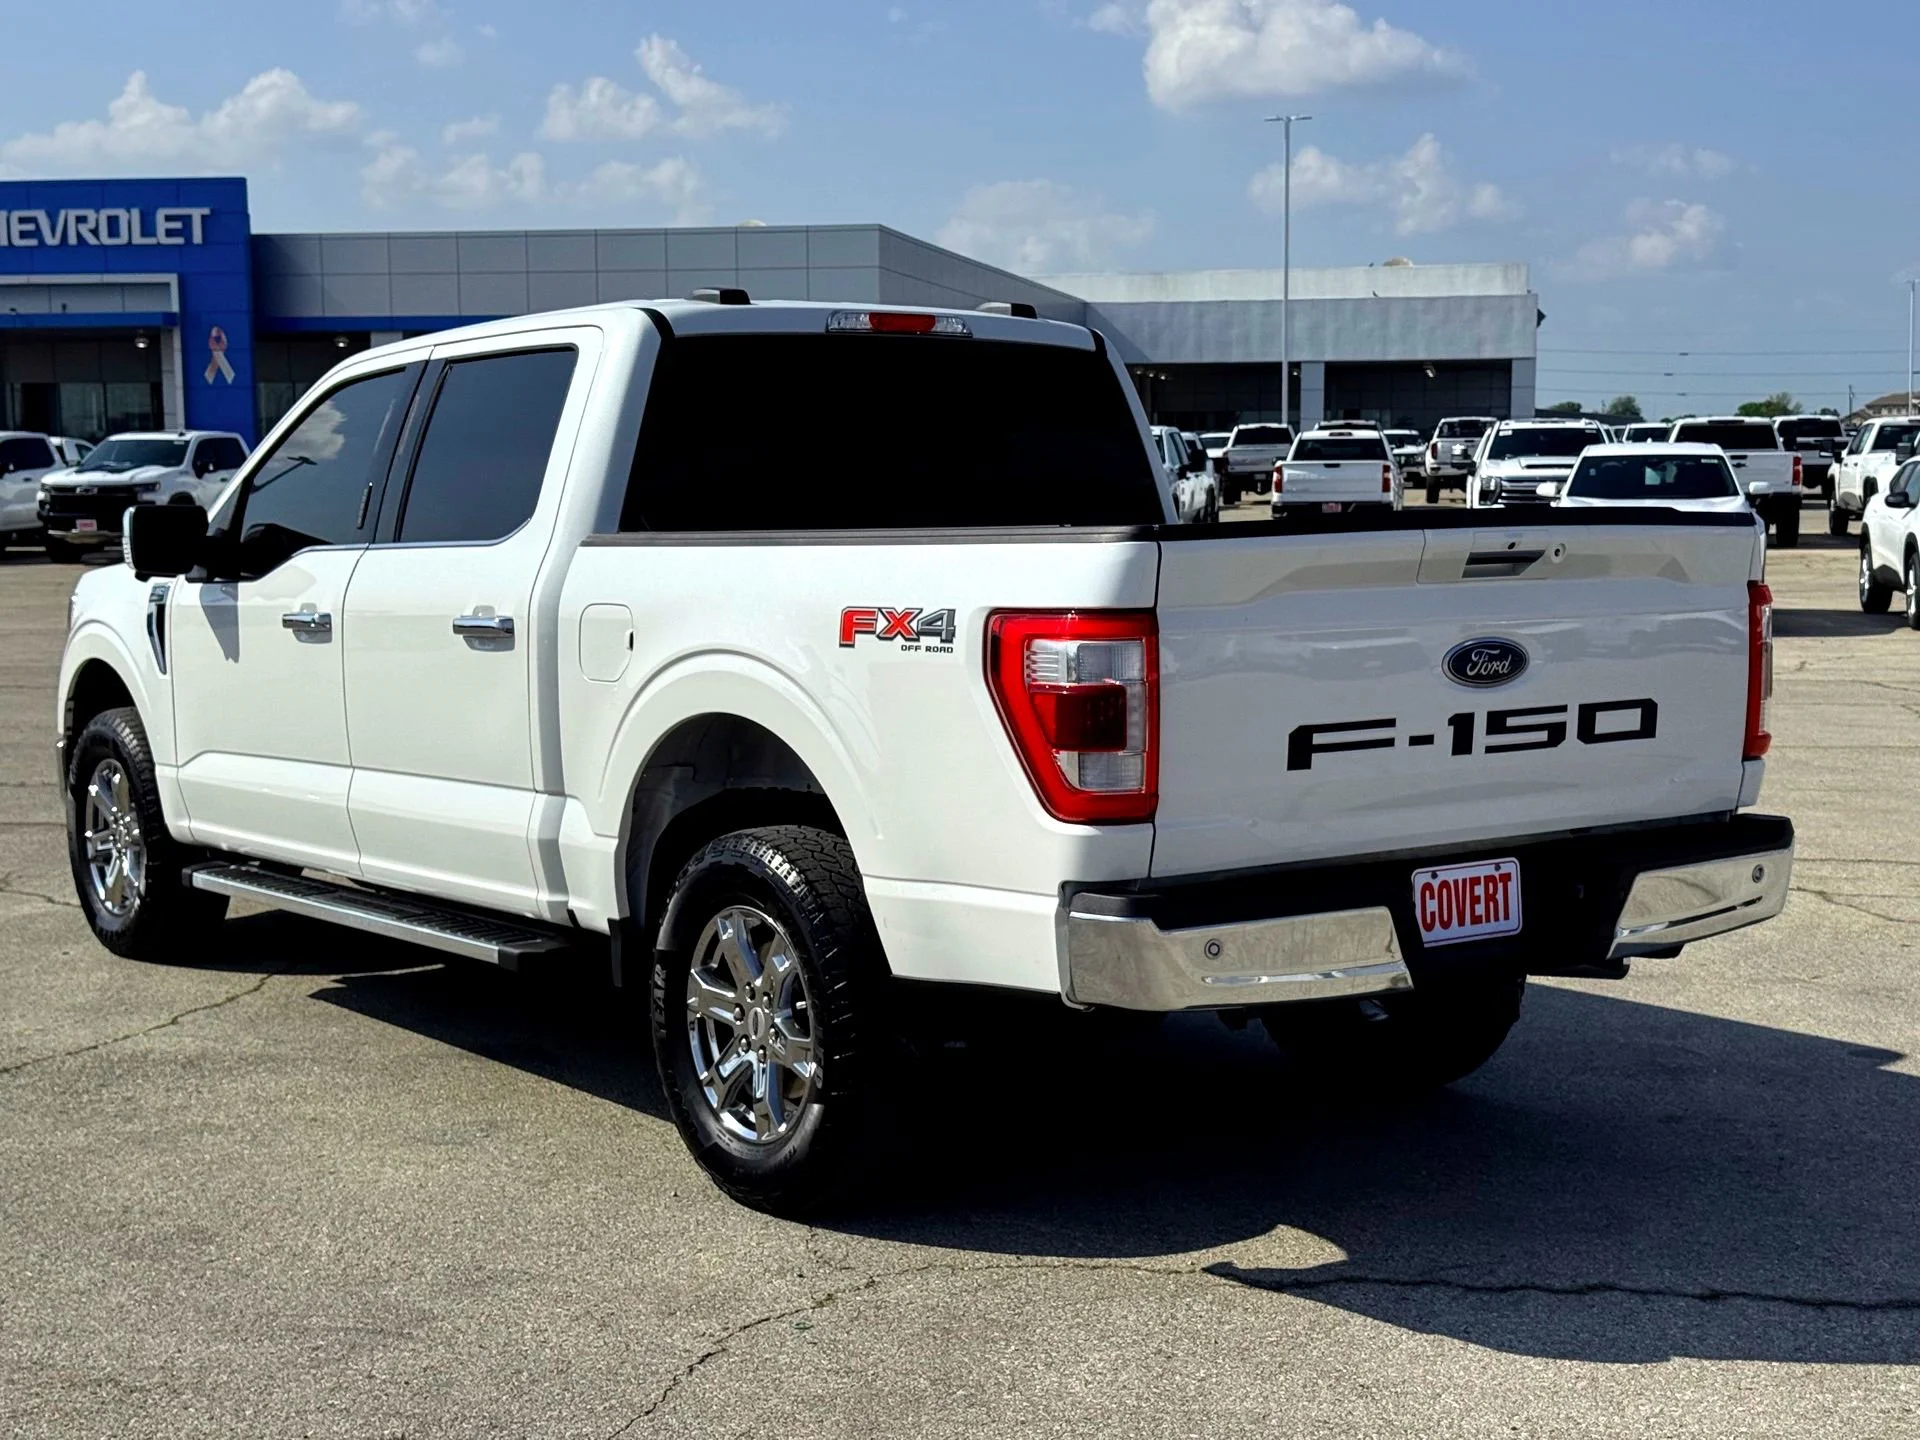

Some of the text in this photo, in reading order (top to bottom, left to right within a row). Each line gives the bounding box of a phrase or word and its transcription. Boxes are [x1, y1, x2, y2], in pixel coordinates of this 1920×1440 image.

[839, 606, 956, 648] FX4
[901, 644, 954, 653] OFF ROAD
[1466, 648, 1512, 676] Ford
[1286, 697, 1659, 771] F-150
[1420, 872, 1512, 933] COVERT
